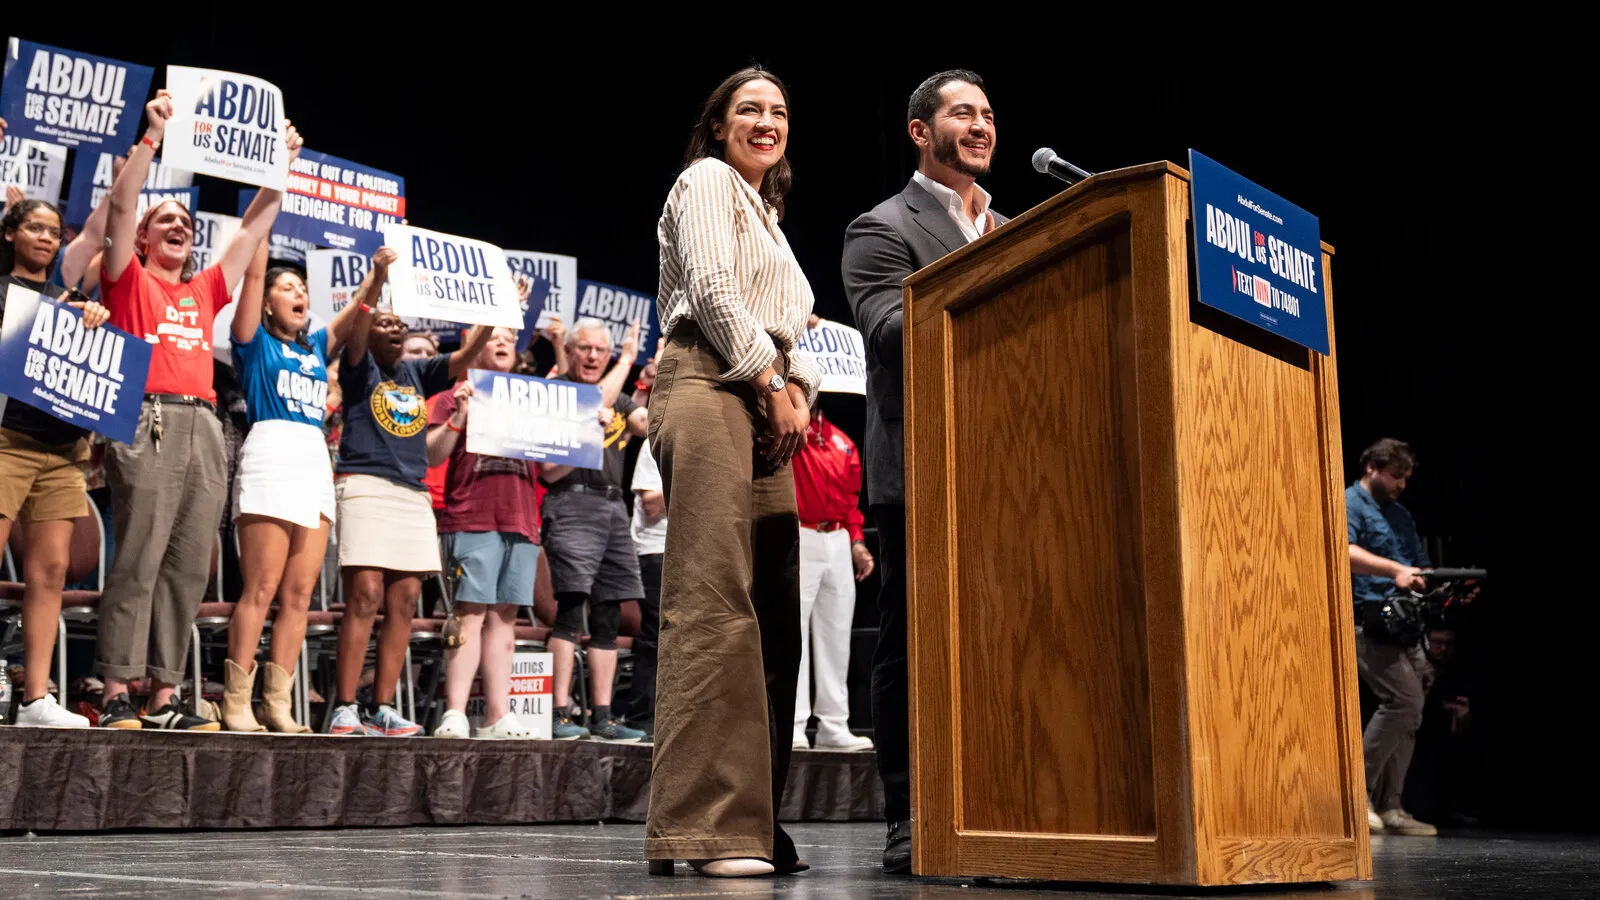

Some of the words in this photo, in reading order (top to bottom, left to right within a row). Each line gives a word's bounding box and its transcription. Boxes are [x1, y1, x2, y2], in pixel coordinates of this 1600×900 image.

[26, 49, 127, 107] ABDUL
[24, 104, 44, 121] US
[44, 96, 122, 136] SENATE
[27, 92, 46, 106] FOR
[194, 76, 279, 133] ABDUL
[193, 134, 211, 149] US
[214, 125, 277, 165] SENATE
[194, 120, 213, 134] FOR
[290, 157, 320, 176] ONEY
[321, 164, 342, 183] OUT
[342, 169, 355, 186] OF
[356, 172, 399, 196] POLITICS
[281, 192, 346, 225] MEDICARE
[349, 206, 374, 231] FOR
[320, 181, 333, 198] IN
[334, 184, 361, 204] YOUR
[362, 189, 399, 213] POCKET
[1237, 194, 1283, 225] AbdulForSenate.com
[1206, 203, 1256, 264] ABDUL
[1254, 230, 1266, 246] FOR
[412, 235, 494, 280] ABDUL
[1255, 245, 1267, 265] US
[1268, 235, 1318, 293] SENATE
[332, 292, 348, 302] FOR
[416, 283, 432, 297] US
[433, 275, 498, 307] SENATE
[578, 284, 650, 330] ABDUL
[1236, 270, 1253, 297] TEXT
[1255, 278, 1270, 306] WIN
[1271, 286, 1281, 310] TO
[1280, 290, 1300, 318] 74801
[27, 347, 48, 366] FOR
[28, 301, 126, 382] ABDUL
[797, 325, 862, 359] ABDUL
[24, 360, 46, 381] US
[44, 356, 122, 415] SENATE
[491, 376, 583, 421] ABDUL
[522, 698, 544, 715] ALL
